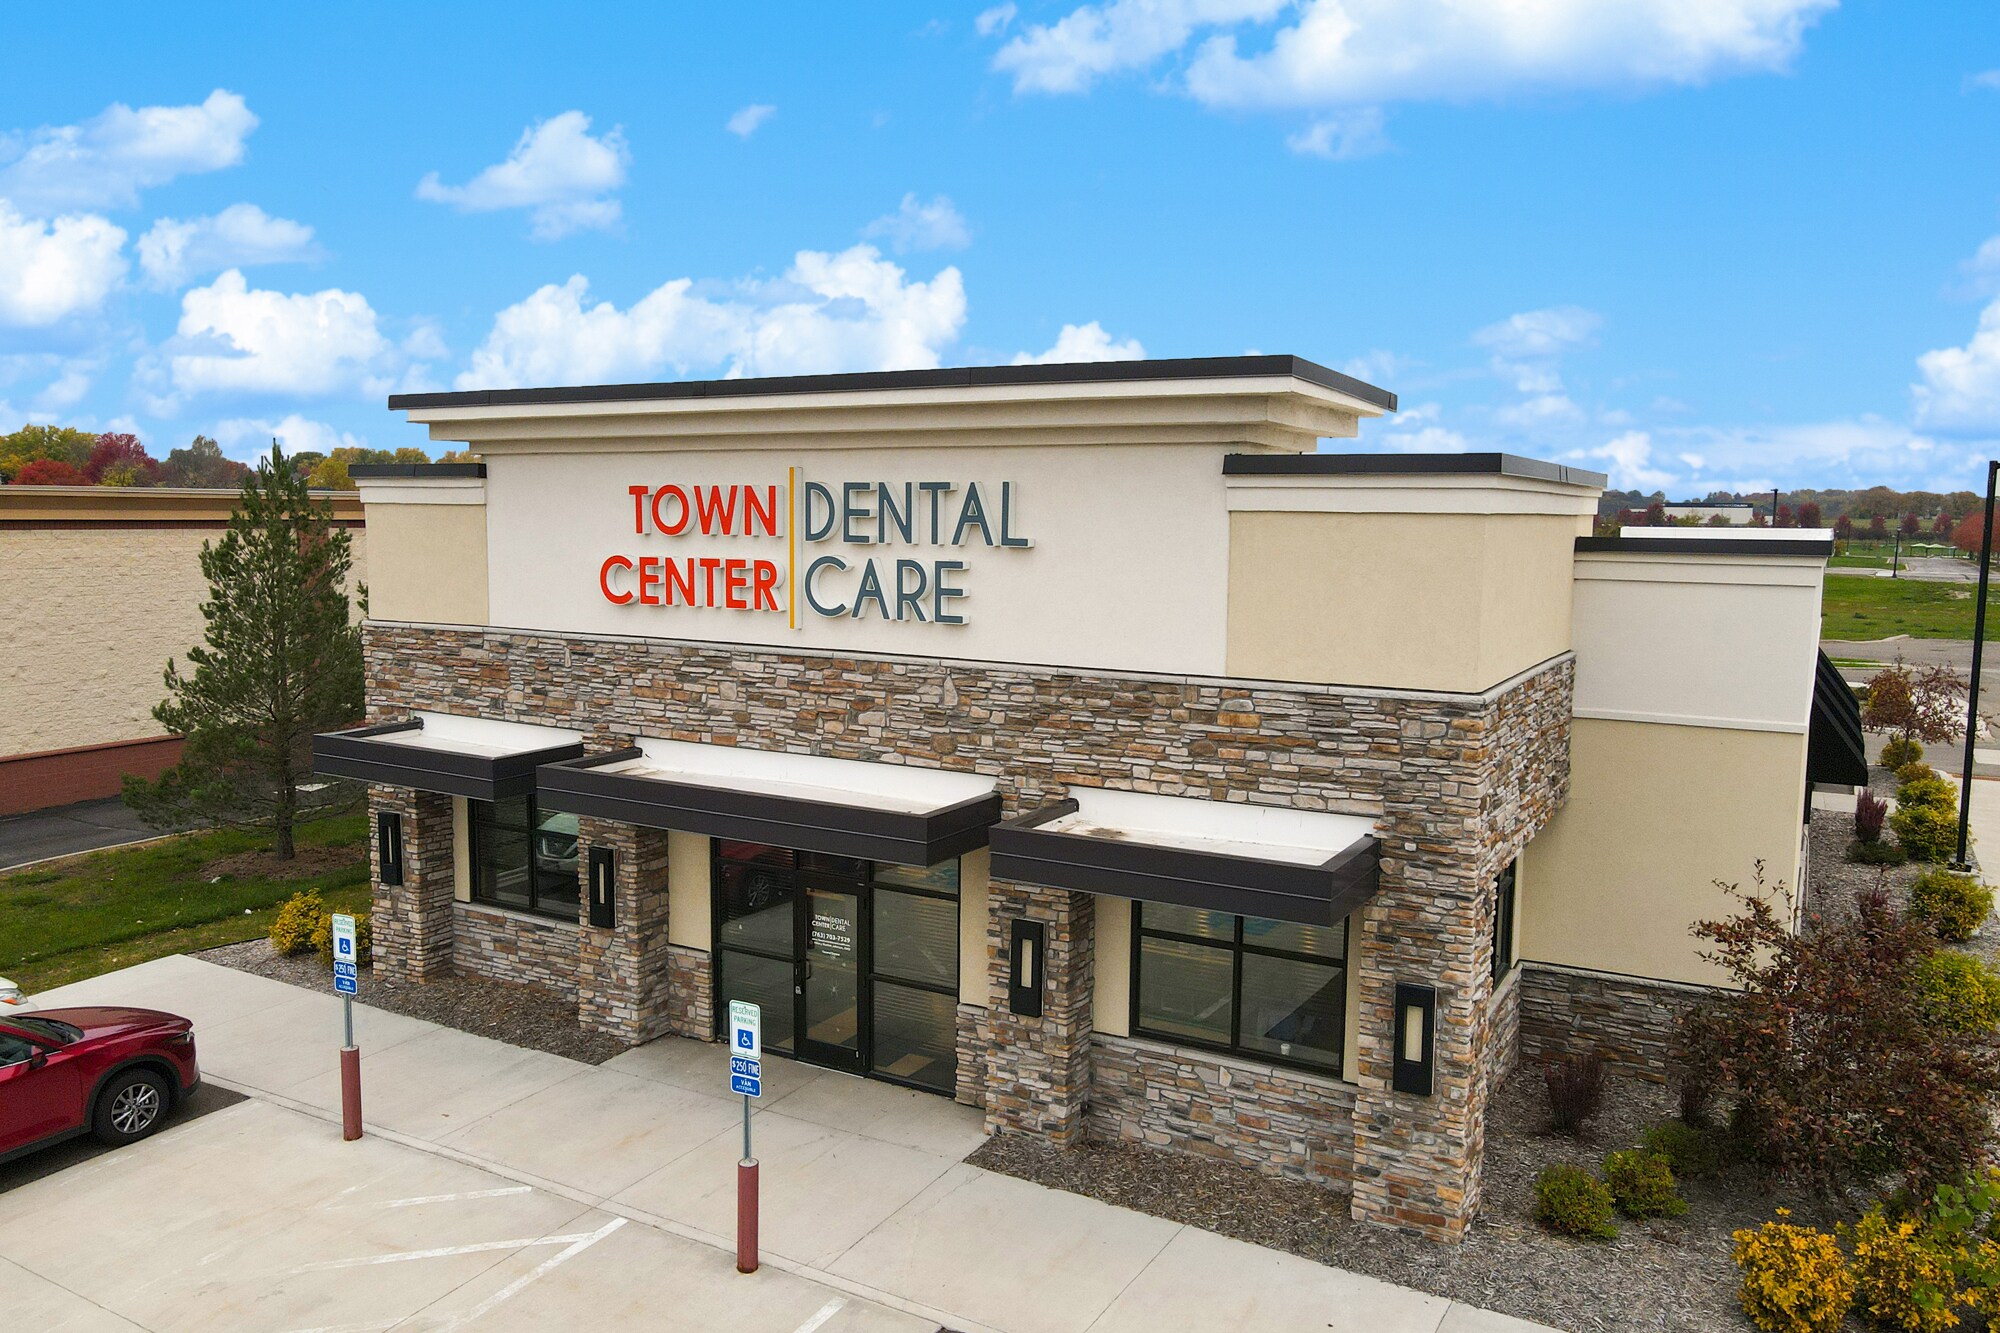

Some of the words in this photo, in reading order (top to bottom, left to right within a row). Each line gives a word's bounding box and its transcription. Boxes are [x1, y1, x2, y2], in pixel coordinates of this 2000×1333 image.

[629, 484, 780, 538] TOWN
[804, 481, 1032, 548] DENTAL
[600, 554, 780, 612] CENTER
[804, 555, 967, 624] CARE
[812, 920, 830, 928] CENTER
[831, 923, 846, 932] CARE
[815, 914, 830, 922] TOWN
[831, 917, 851, 927] DENTAL
[812, 931, 825, 939] (763)
[732, 1005, 758, 1018] RESERVED
[733, 1015, 756, 1026] PARKING
[732, 1060, 747, 1073] $250
[748, 1063, 760, 1076] FINE
